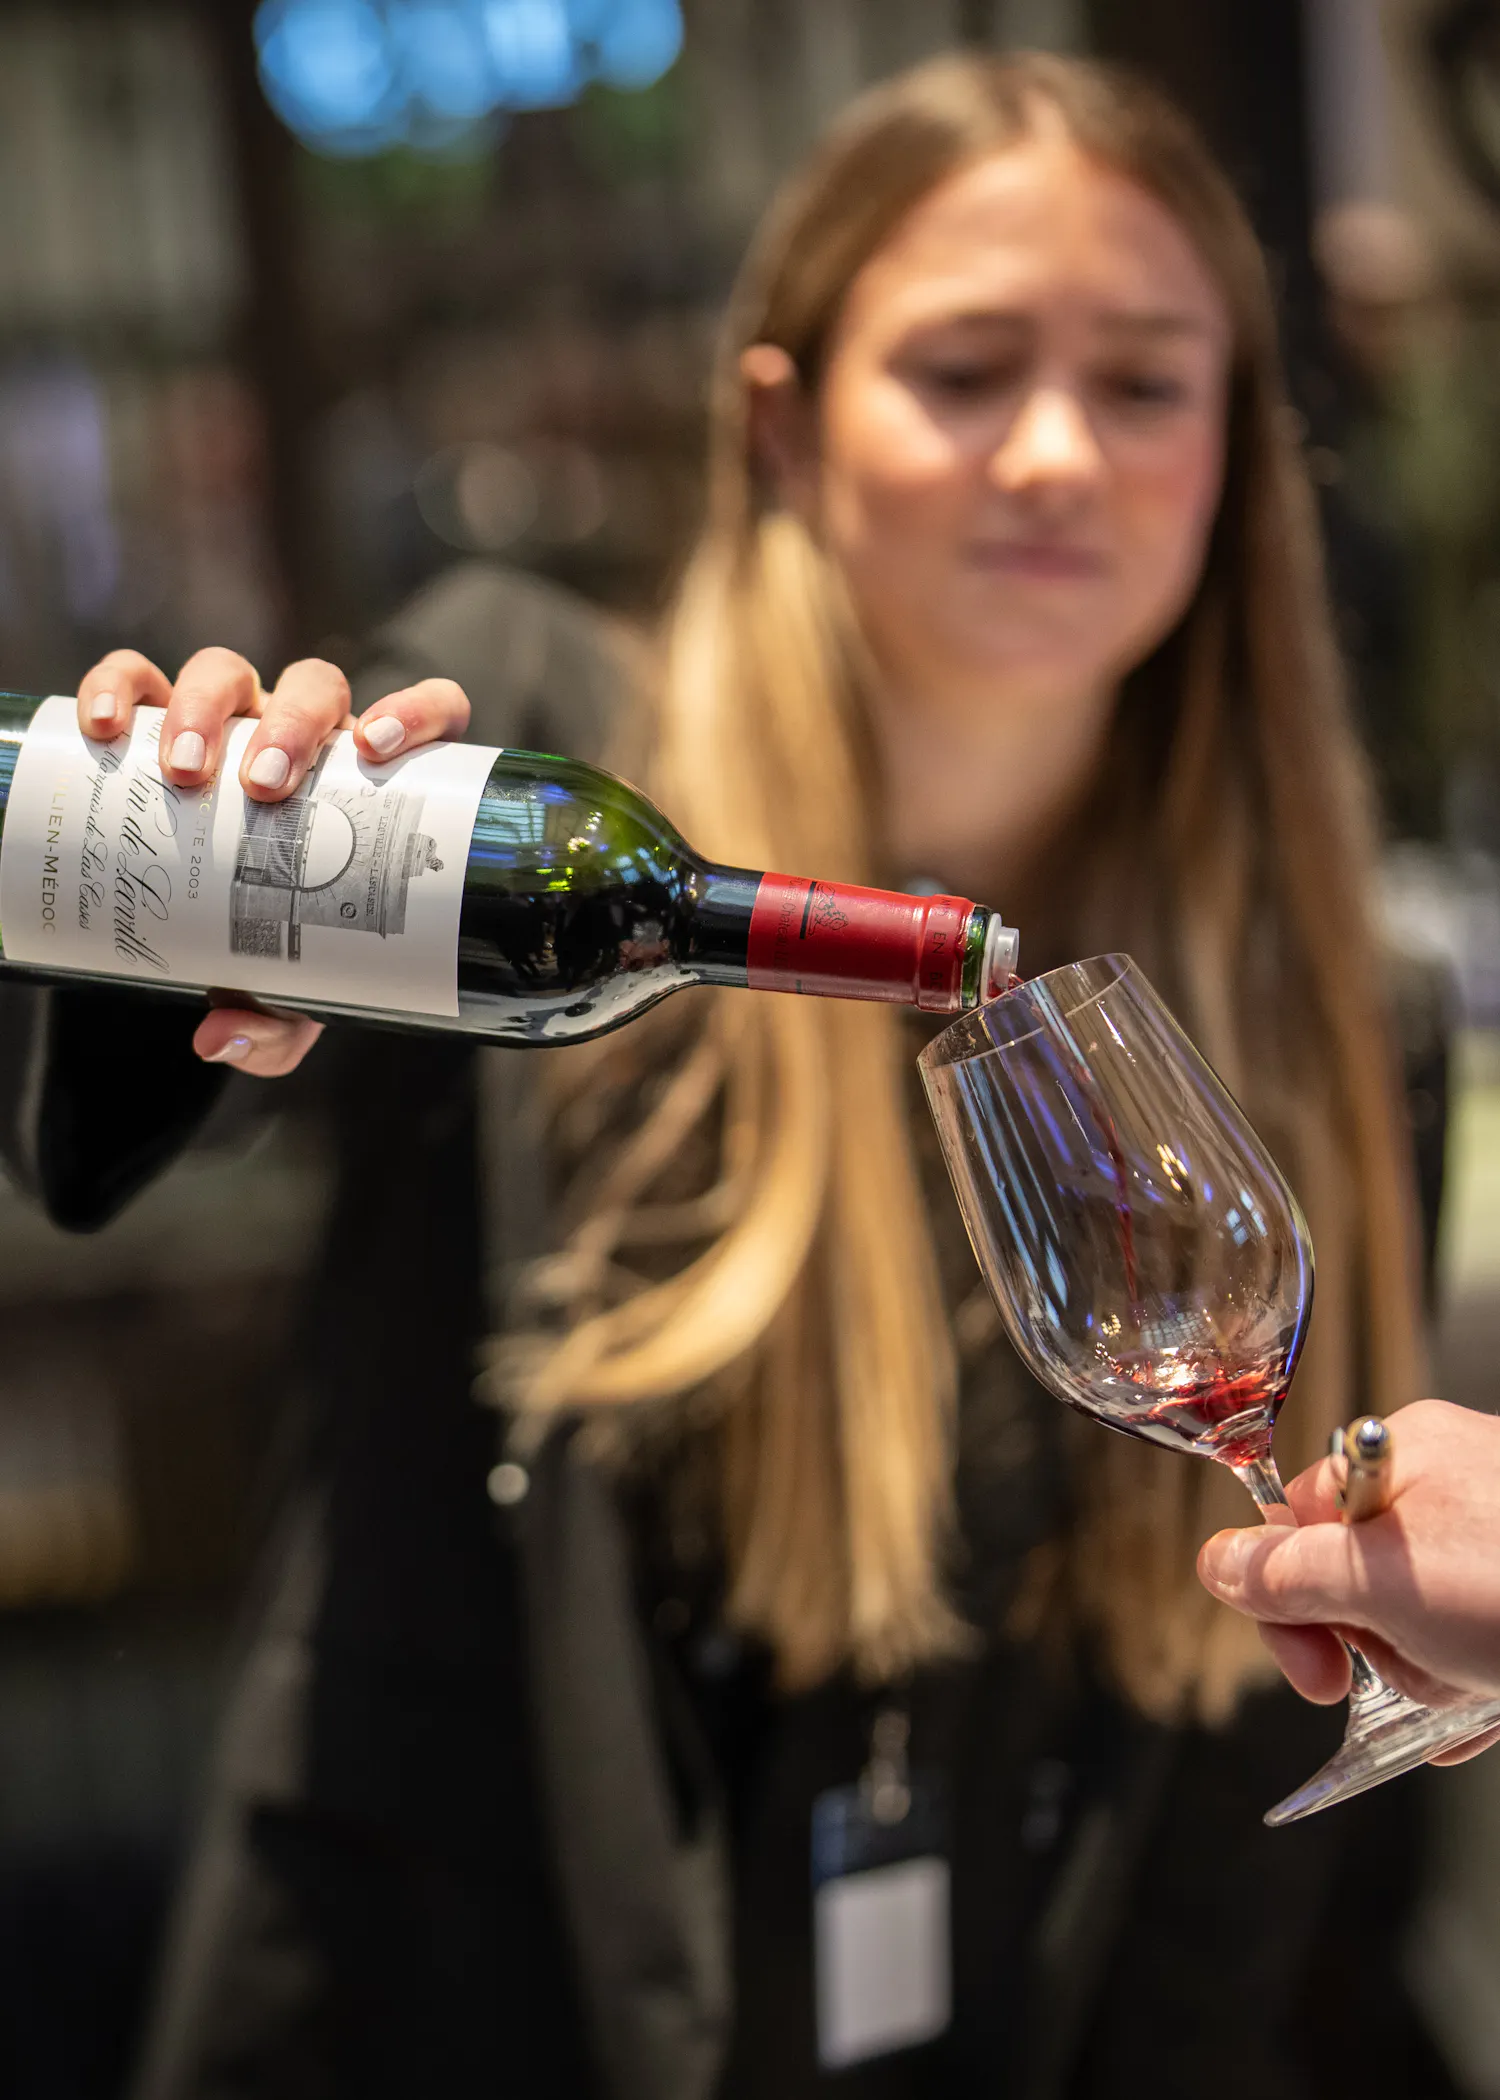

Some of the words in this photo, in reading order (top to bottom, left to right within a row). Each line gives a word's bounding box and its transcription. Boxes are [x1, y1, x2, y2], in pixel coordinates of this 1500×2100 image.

[86, 740, 124, 815] Marquis
[127, 766, 184, 838] Vin
[84, 814, 106, 840] de
[119, 814, 157, 857] de
[80, 839, 108, 881] Las
[187, 855, 202, 900] 2003
[79, 881, 105, 931] Cases
[932, 932, 947, 956] EN
